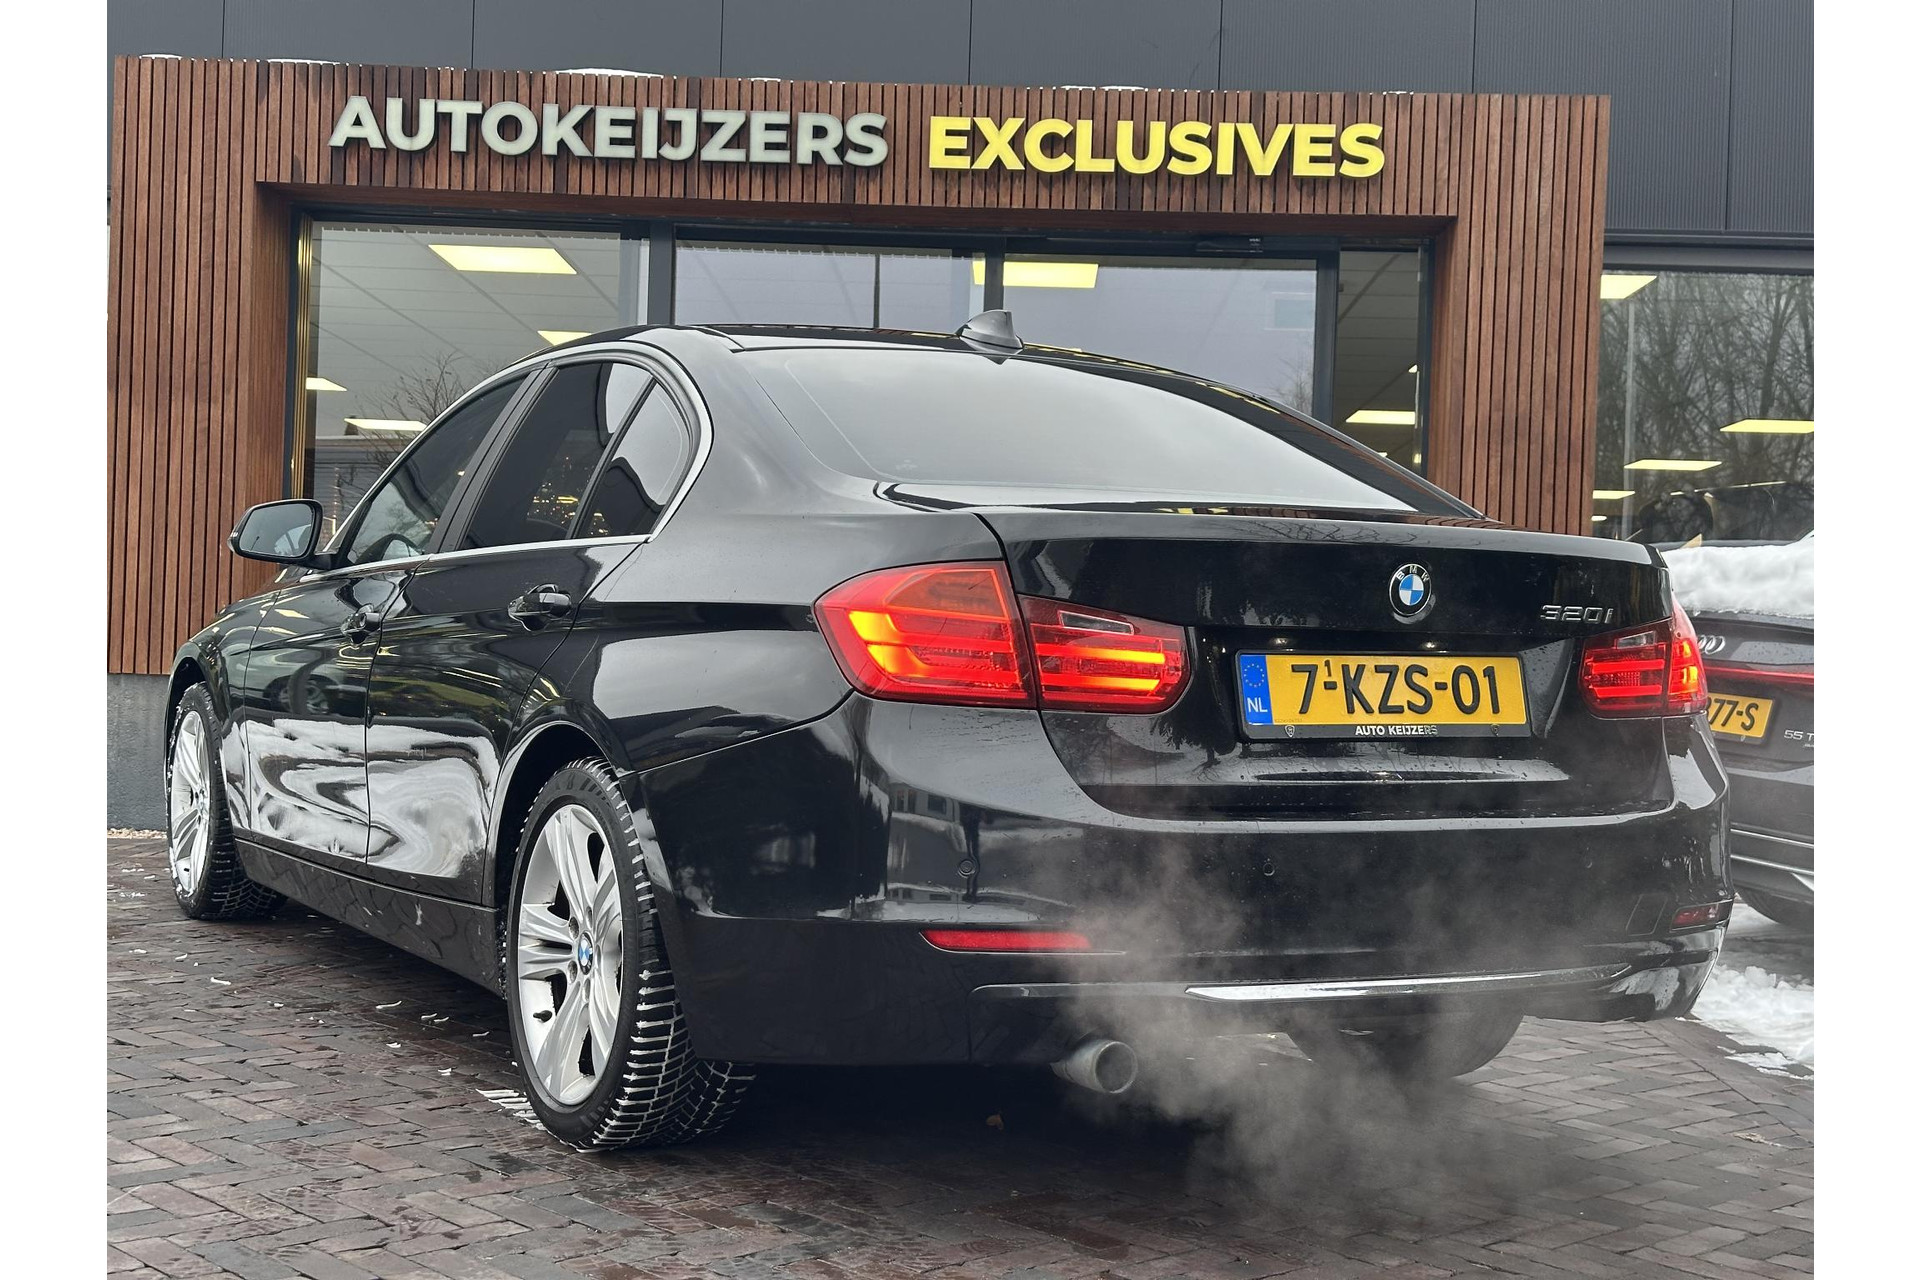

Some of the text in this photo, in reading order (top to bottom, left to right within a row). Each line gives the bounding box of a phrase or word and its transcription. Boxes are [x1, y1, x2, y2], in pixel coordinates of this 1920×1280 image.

[328, 95, 1386, 179] AUTOKEIJZERS EXCLUSIVES
[1396, 565, 1430, 582] BMW
[1540, 604, 1614, 624] 320i
[1248, 697, 1268, 713] NL
[1706, 697, 1759, 731] 77-S
[1355, 725, 1438, 736] AUTO KEIJZERS
